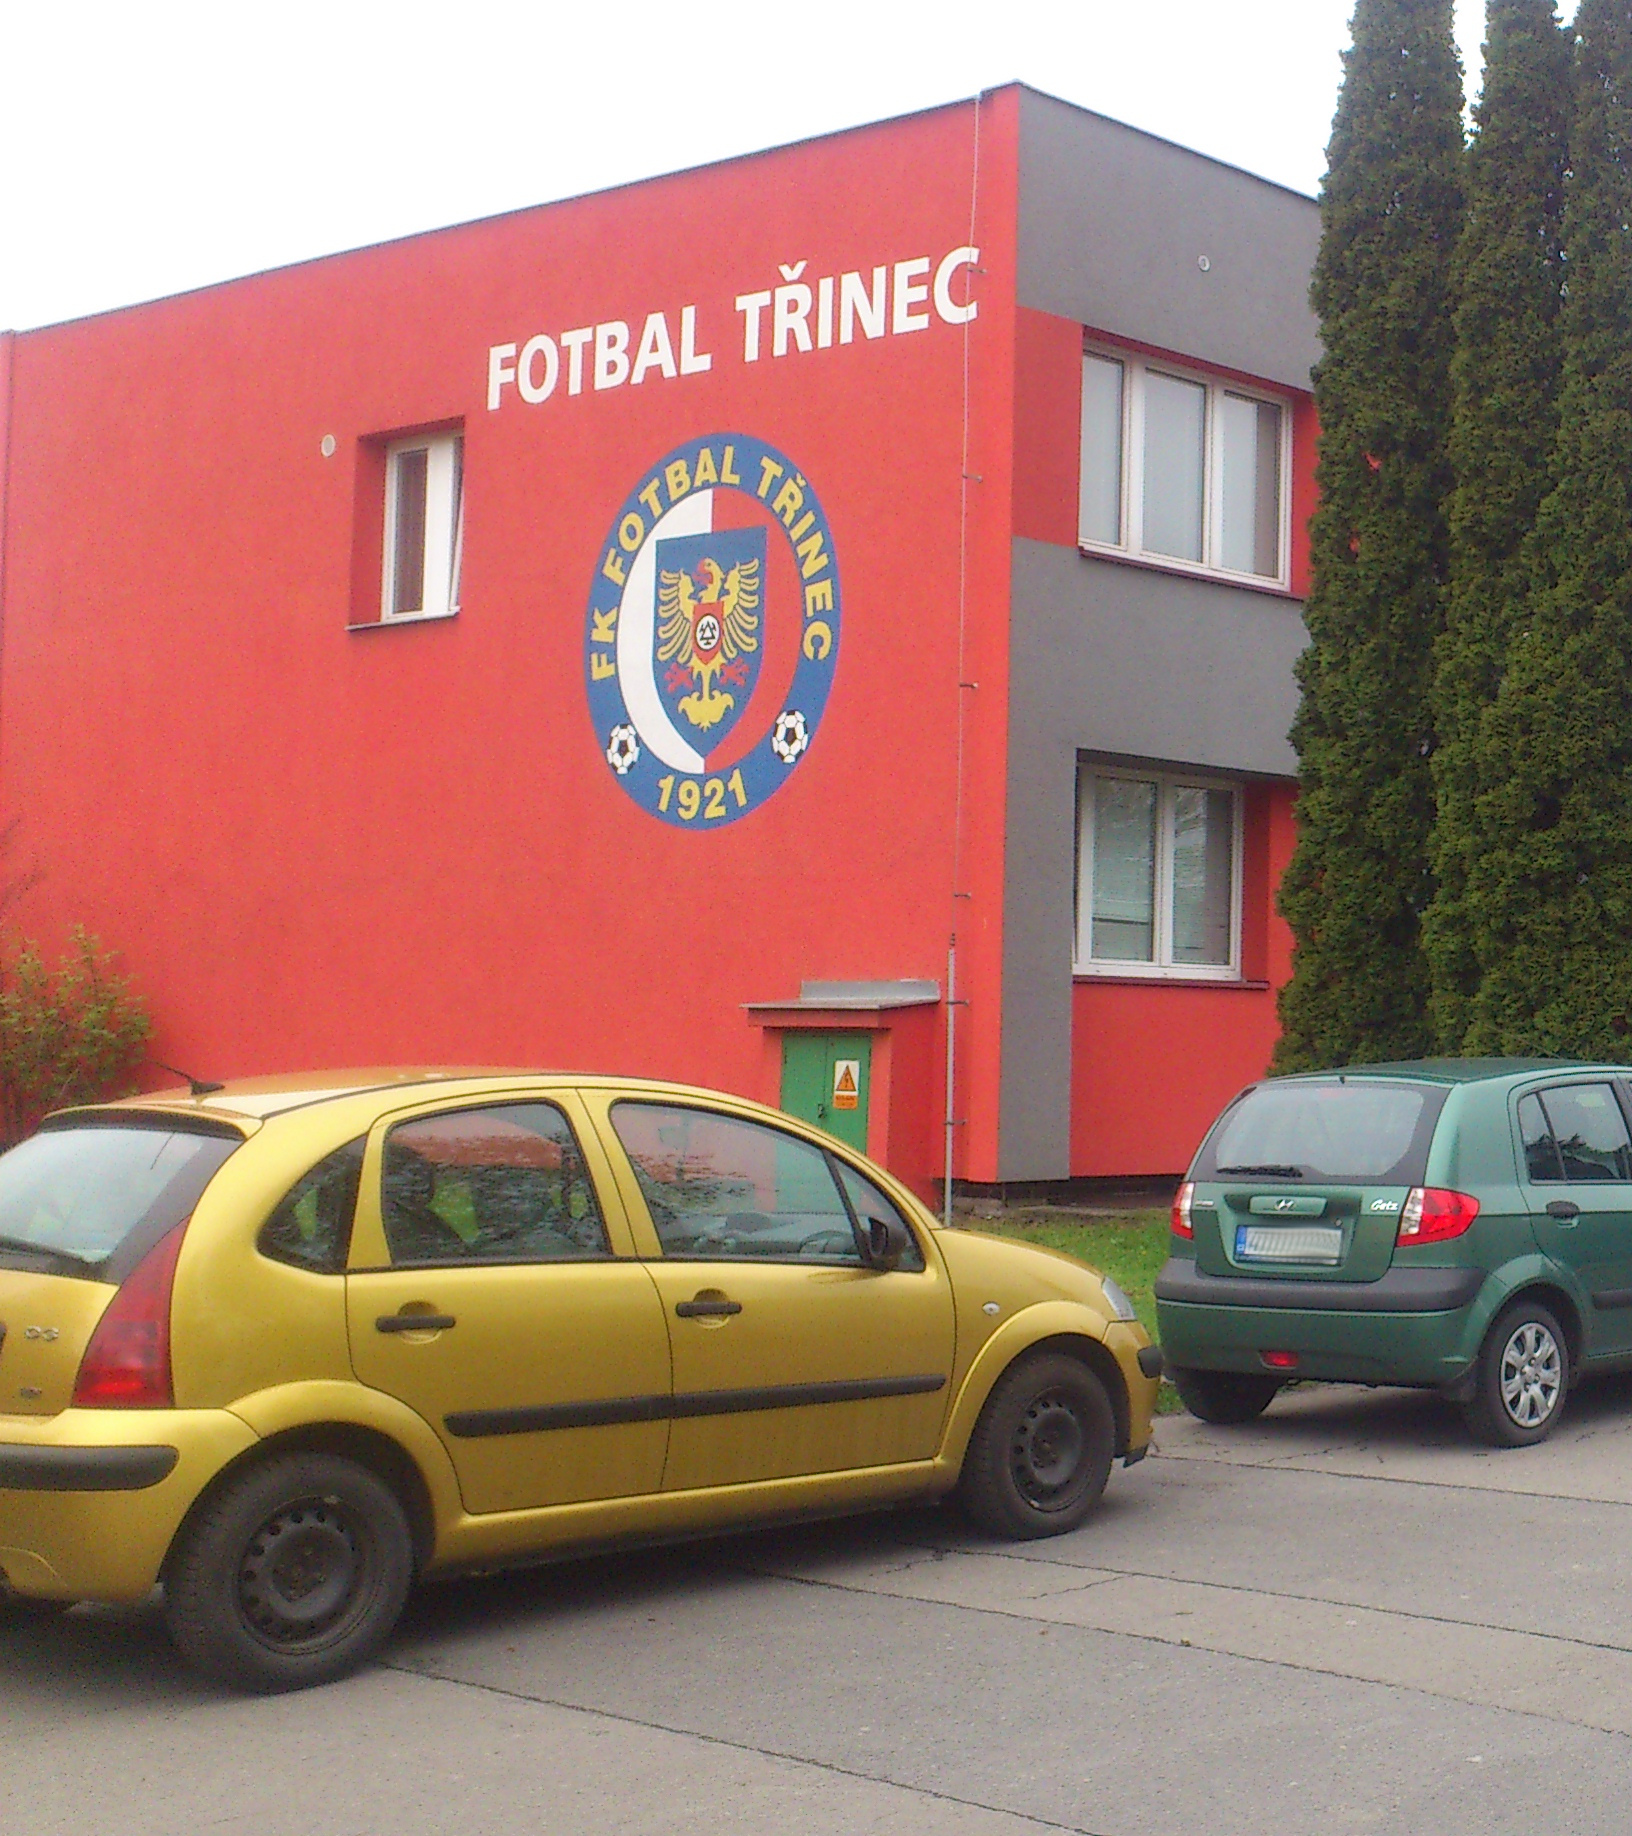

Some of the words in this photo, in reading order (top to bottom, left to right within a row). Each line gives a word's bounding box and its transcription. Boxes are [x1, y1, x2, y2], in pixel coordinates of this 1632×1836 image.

[486, 305, 712, 411] FOTBAL
[735, 246, 980, 363] TŘINEC
[602, 445, 740, 587] FOTBAL
[758, 456, 834, 660] TŘINEC
[591, 607, 616, 681] FK
[656, 768, 748, 820] 1921
[1370, 1198, 1399, 1211] Getz
